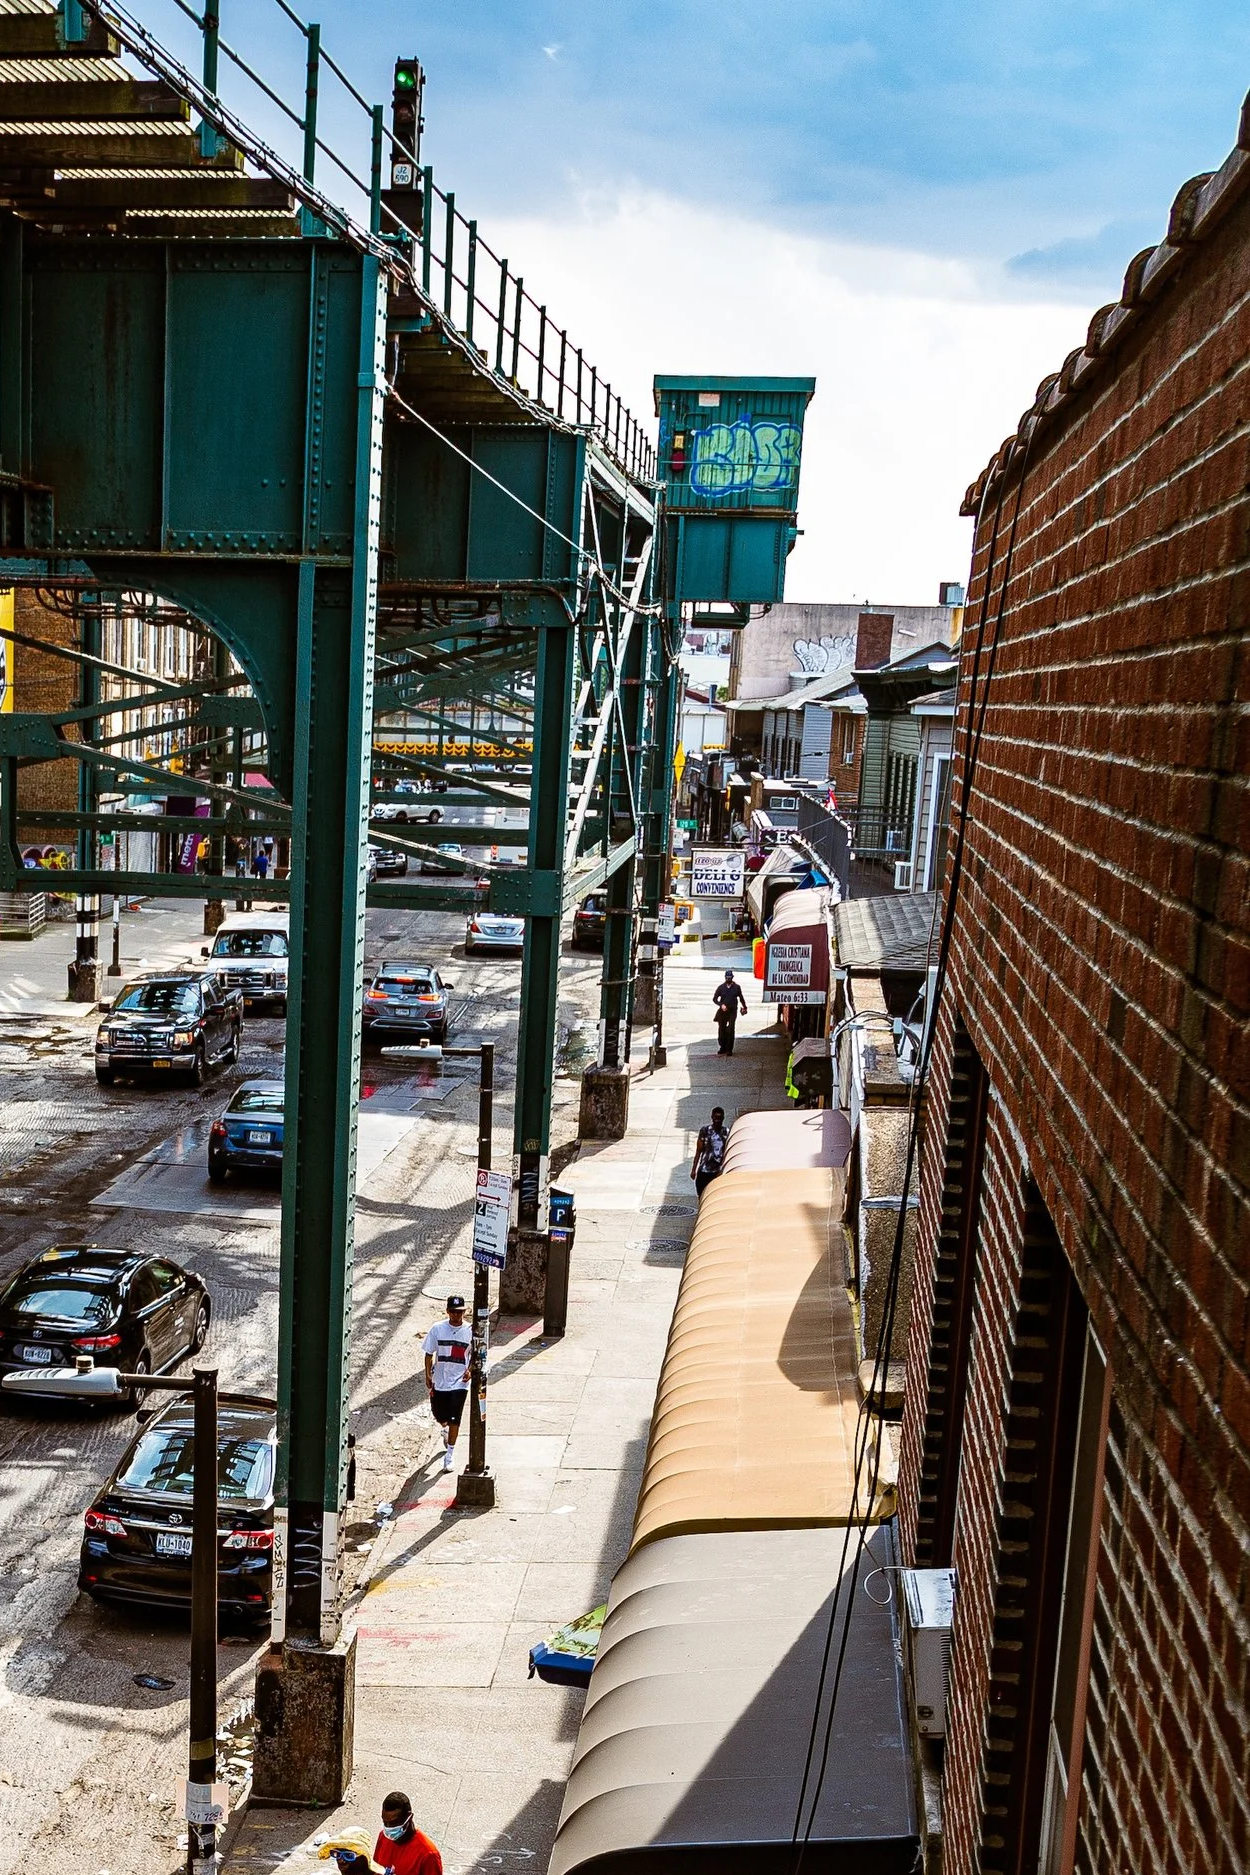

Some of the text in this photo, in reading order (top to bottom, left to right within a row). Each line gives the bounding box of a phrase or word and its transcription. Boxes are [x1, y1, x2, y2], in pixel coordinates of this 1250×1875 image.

[395, 174, 409, 182] 590
[696, 882, 735, 895] CONVENIENCE
[771, 947, 810, 958] IGLESIA CRISTIANA
[772, 974, 809, 984] DE LA COMUNIDAD
[770, 992, 808, 1003] Mateo 6:33
[478, 1203, 484, 1214] 2
[556, 1208, 565, 1221] P
